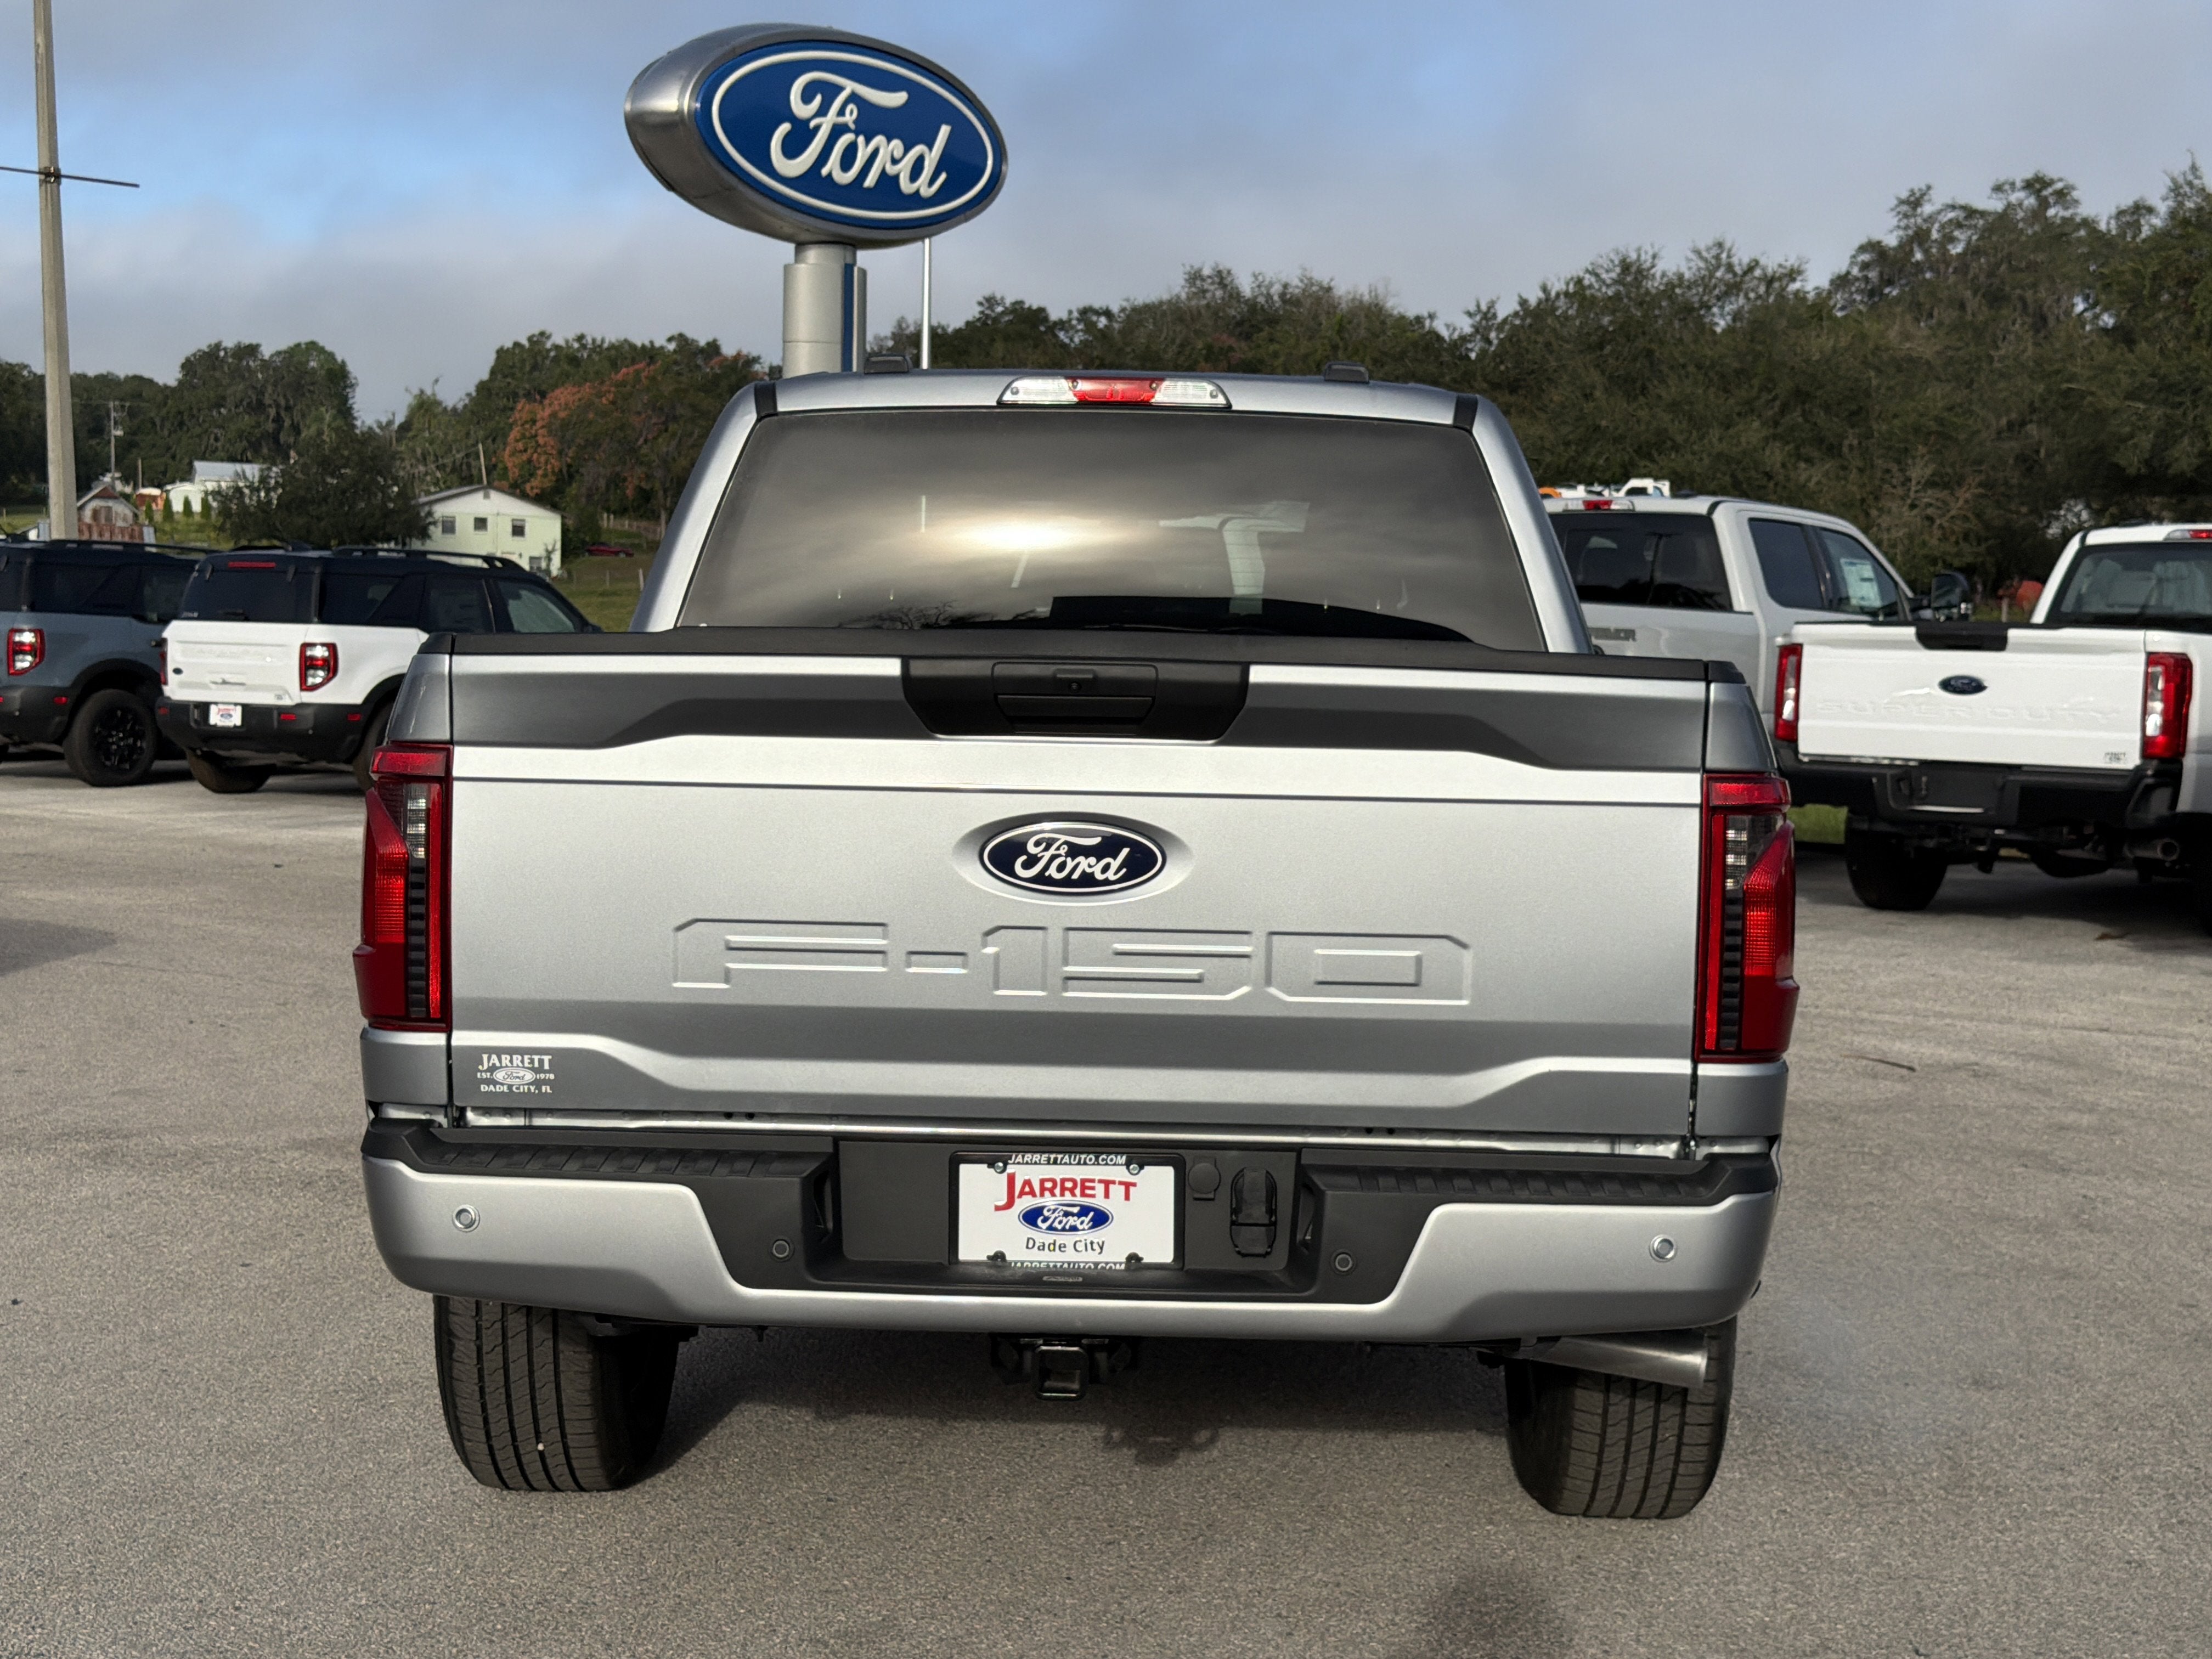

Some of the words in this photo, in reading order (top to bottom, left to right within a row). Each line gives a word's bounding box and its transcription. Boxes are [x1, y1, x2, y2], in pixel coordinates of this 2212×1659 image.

[770, 71, 952, 199] Ford
[1816, 698, 1973, 719] SUPER
[1014, 833, 1131, 881] Ford
[673, 917, 1472, 1006] F-150
[478, 1053, 552, 1070] JARRETT
[502, 1070, 527, 1081] Ford
[481, 1084, 510, 1092] DADE
[512, 1085, 538, 1094] CITY,
[1008, 1154, 1126, 1165] JARRETTAUTO.COM
[994, 1169, 1137, 1212] JARRETT
[1036, 1205, 1094, 1231] Ford
[1025, 1237, 1068, 1253] Dade
[1073, 1238, 1105, 1255] City
